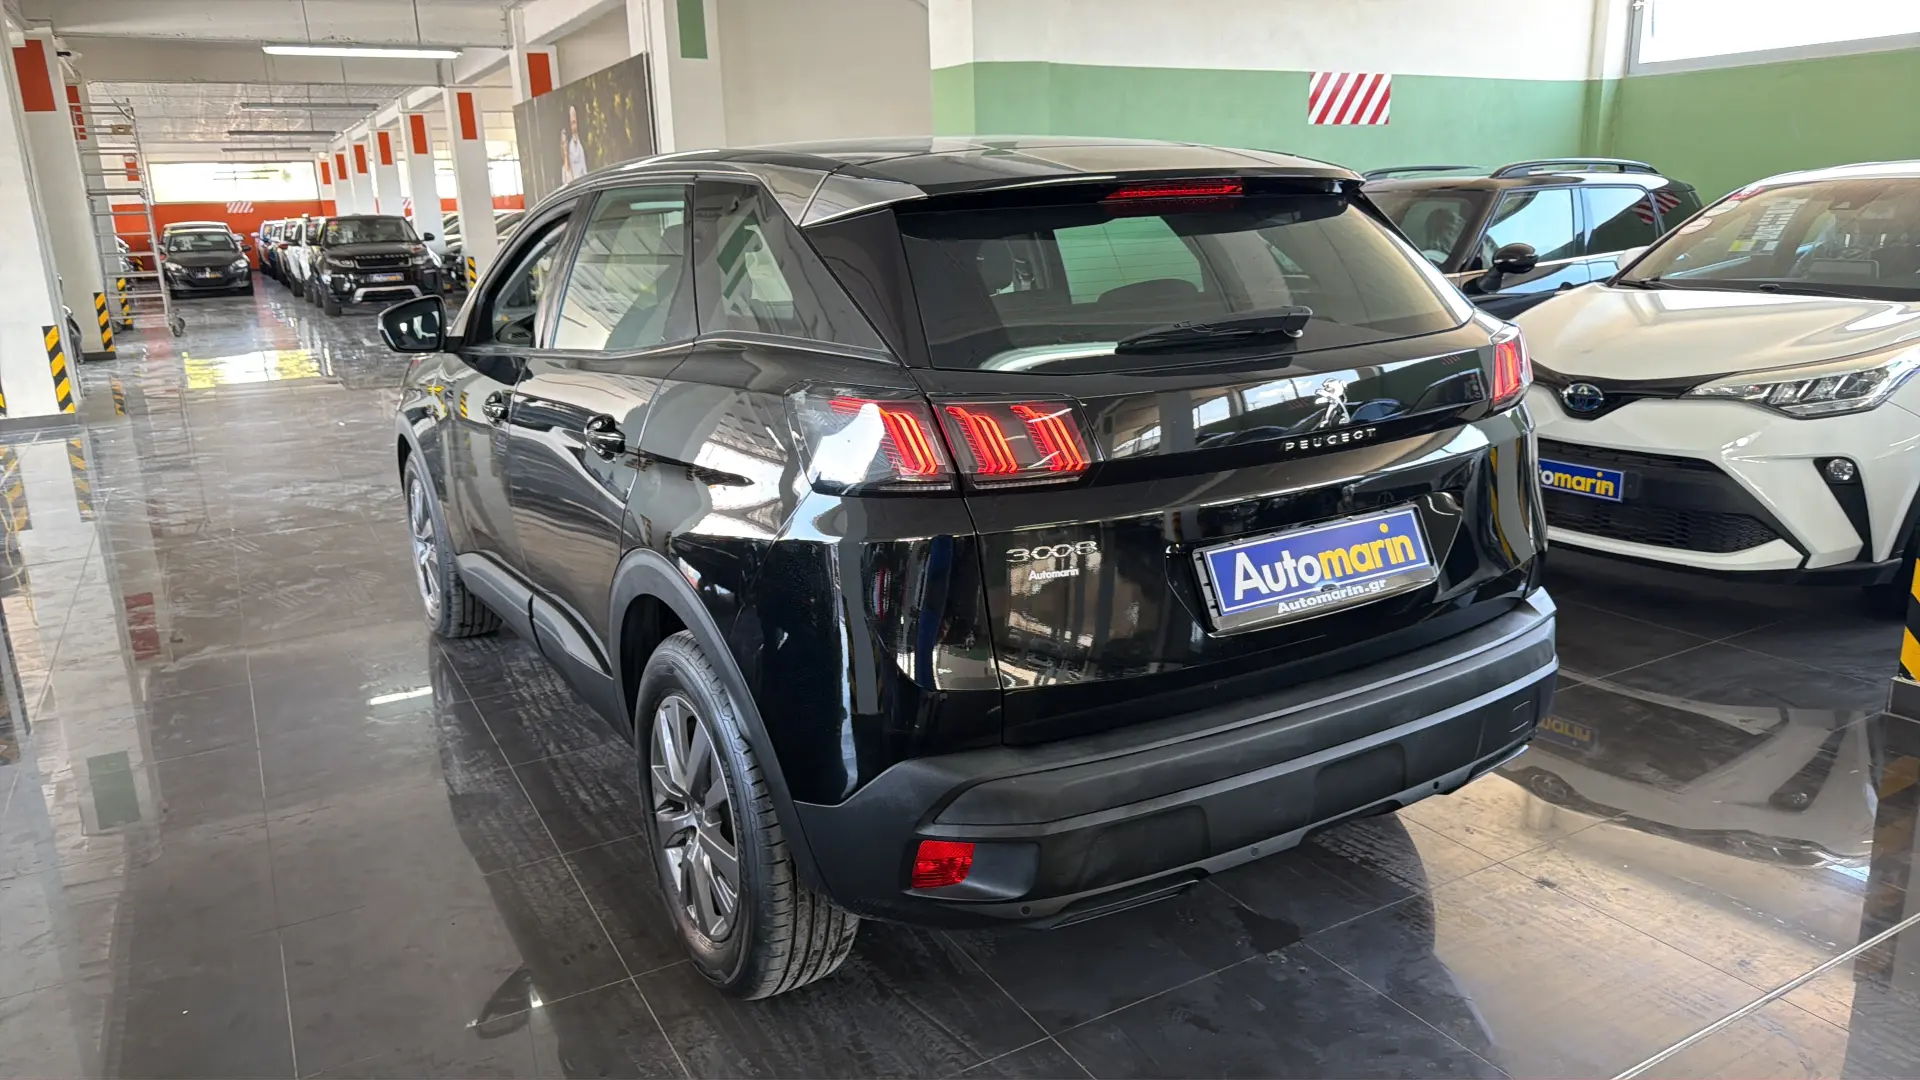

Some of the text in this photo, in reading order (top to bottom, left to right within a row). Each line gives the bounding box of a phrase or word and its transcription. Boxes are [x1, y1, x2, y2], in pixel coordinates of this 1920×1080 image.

[1285, 427, 1377, 452] PEUGEOT
[1539, 465, 1615, 497] omarin
[1005, 540, 1098, 563] 3008
[1233, 522, 1417, 601] Automarin
[1028, 565, 1080, 581] Automarin
[1277, 579, 1388, 614] Automarin.gr
